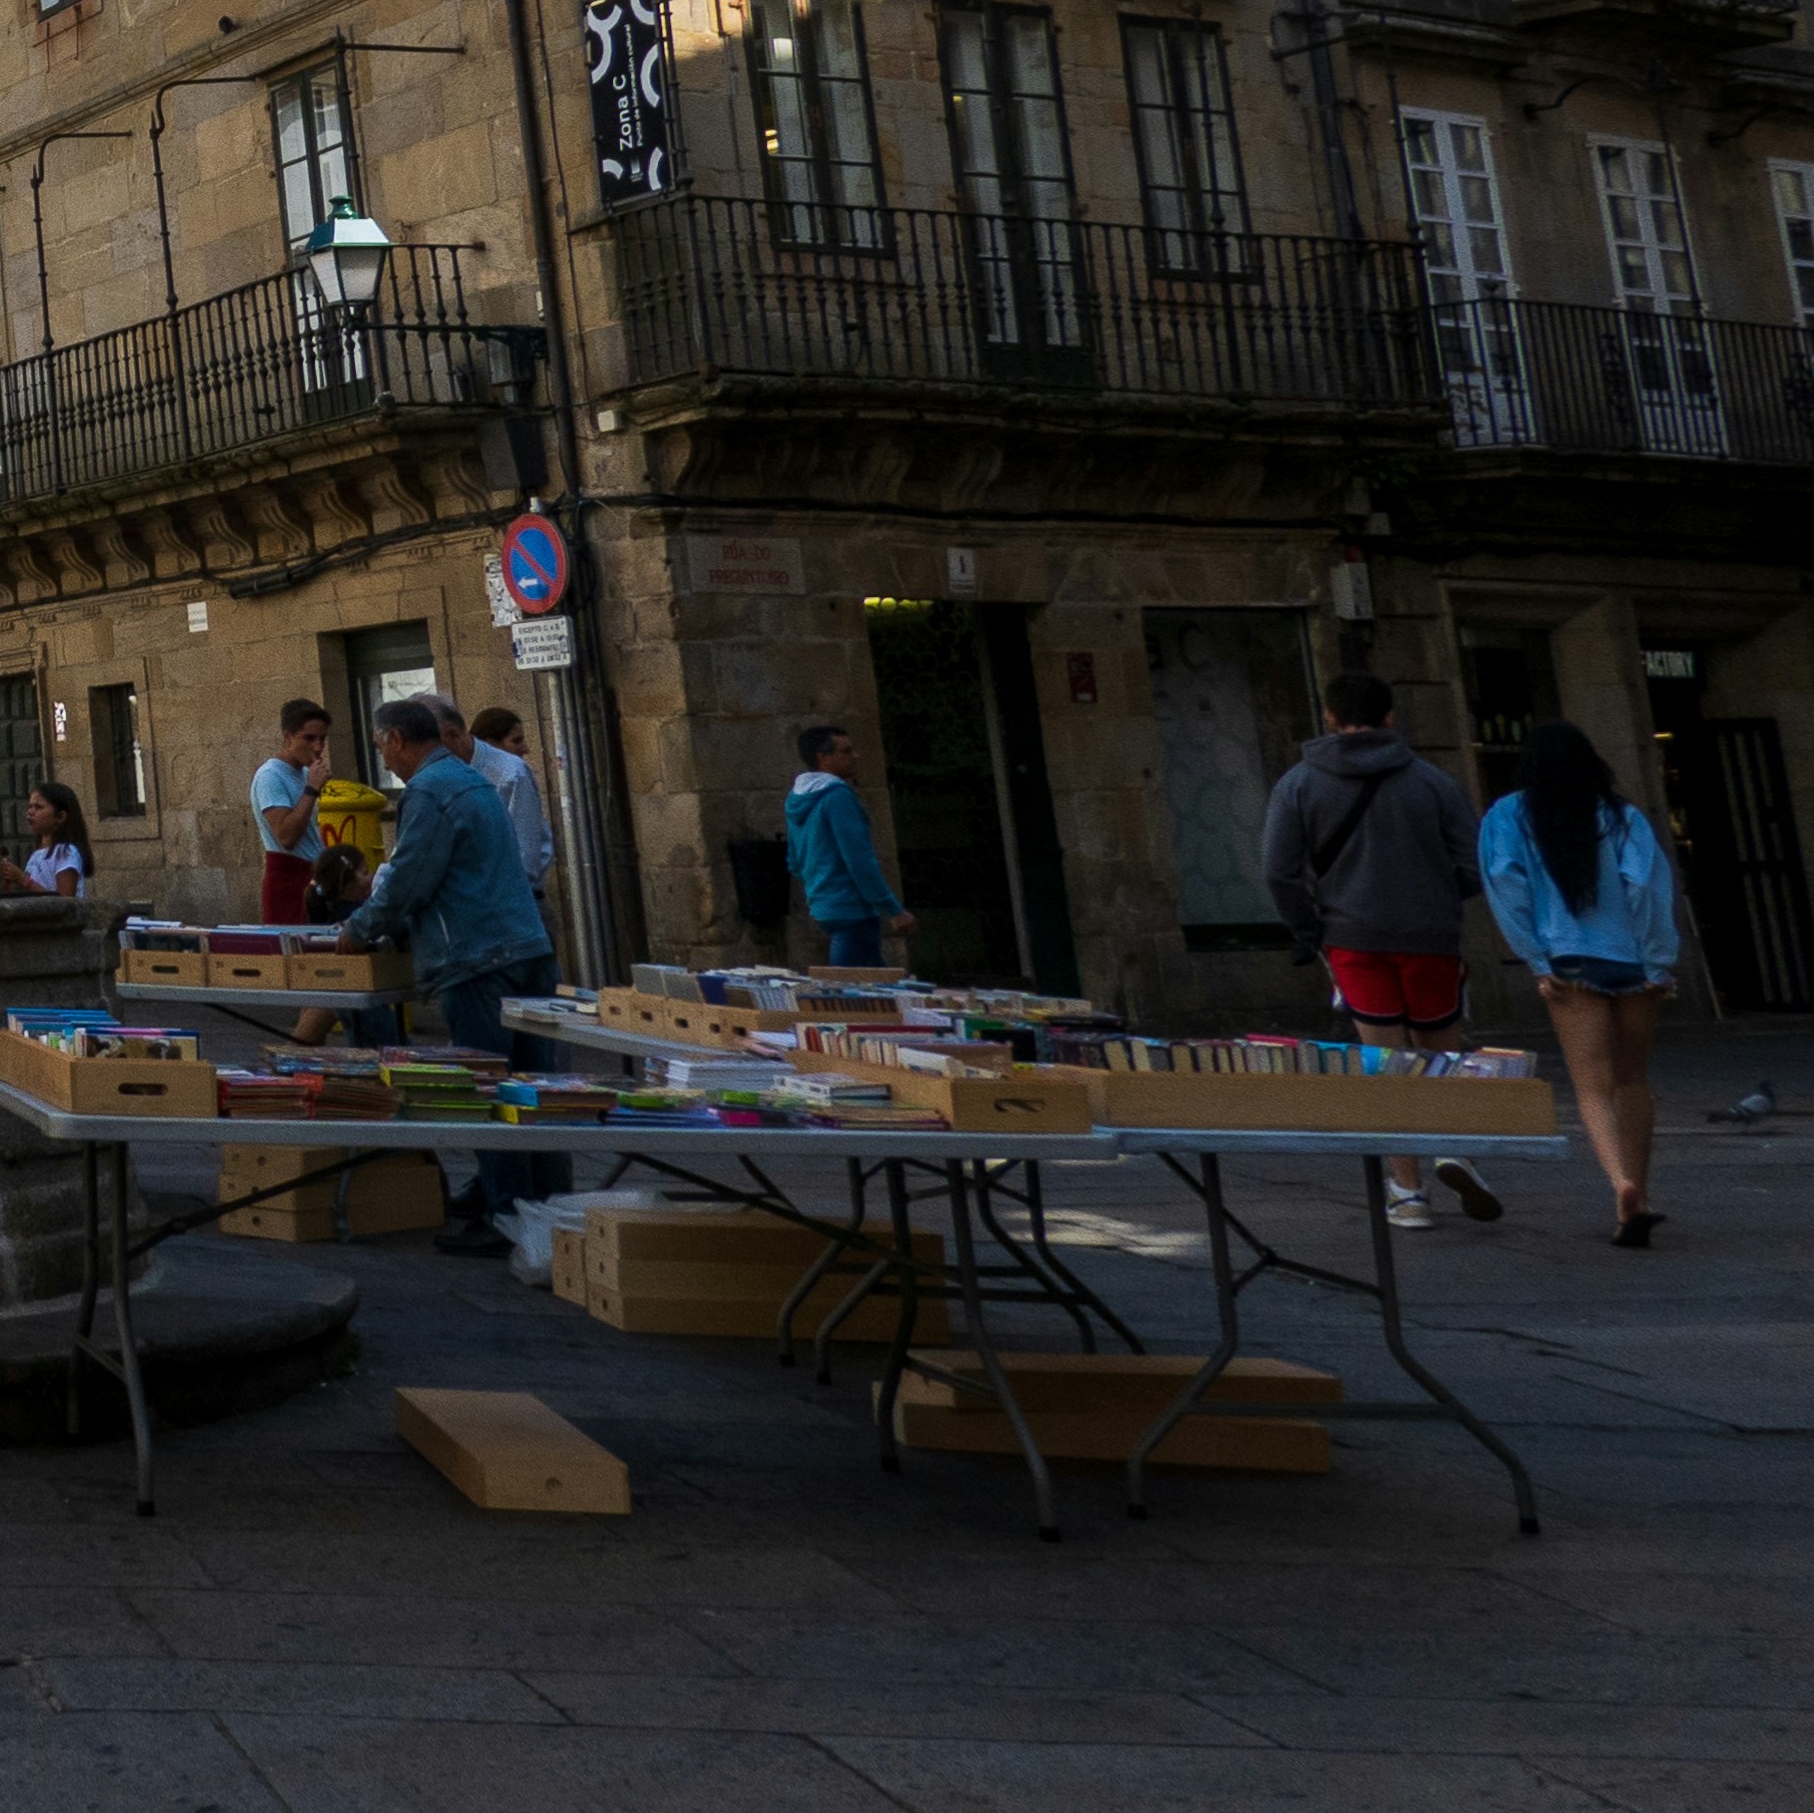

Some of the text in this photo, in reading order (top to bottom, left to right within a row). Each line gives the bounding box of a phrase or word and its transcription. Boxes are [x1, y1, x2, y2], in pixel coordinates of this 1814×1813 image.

[613, 74, 633, 151] Zona C
[722, 539, 771, 560] RÚA DO
